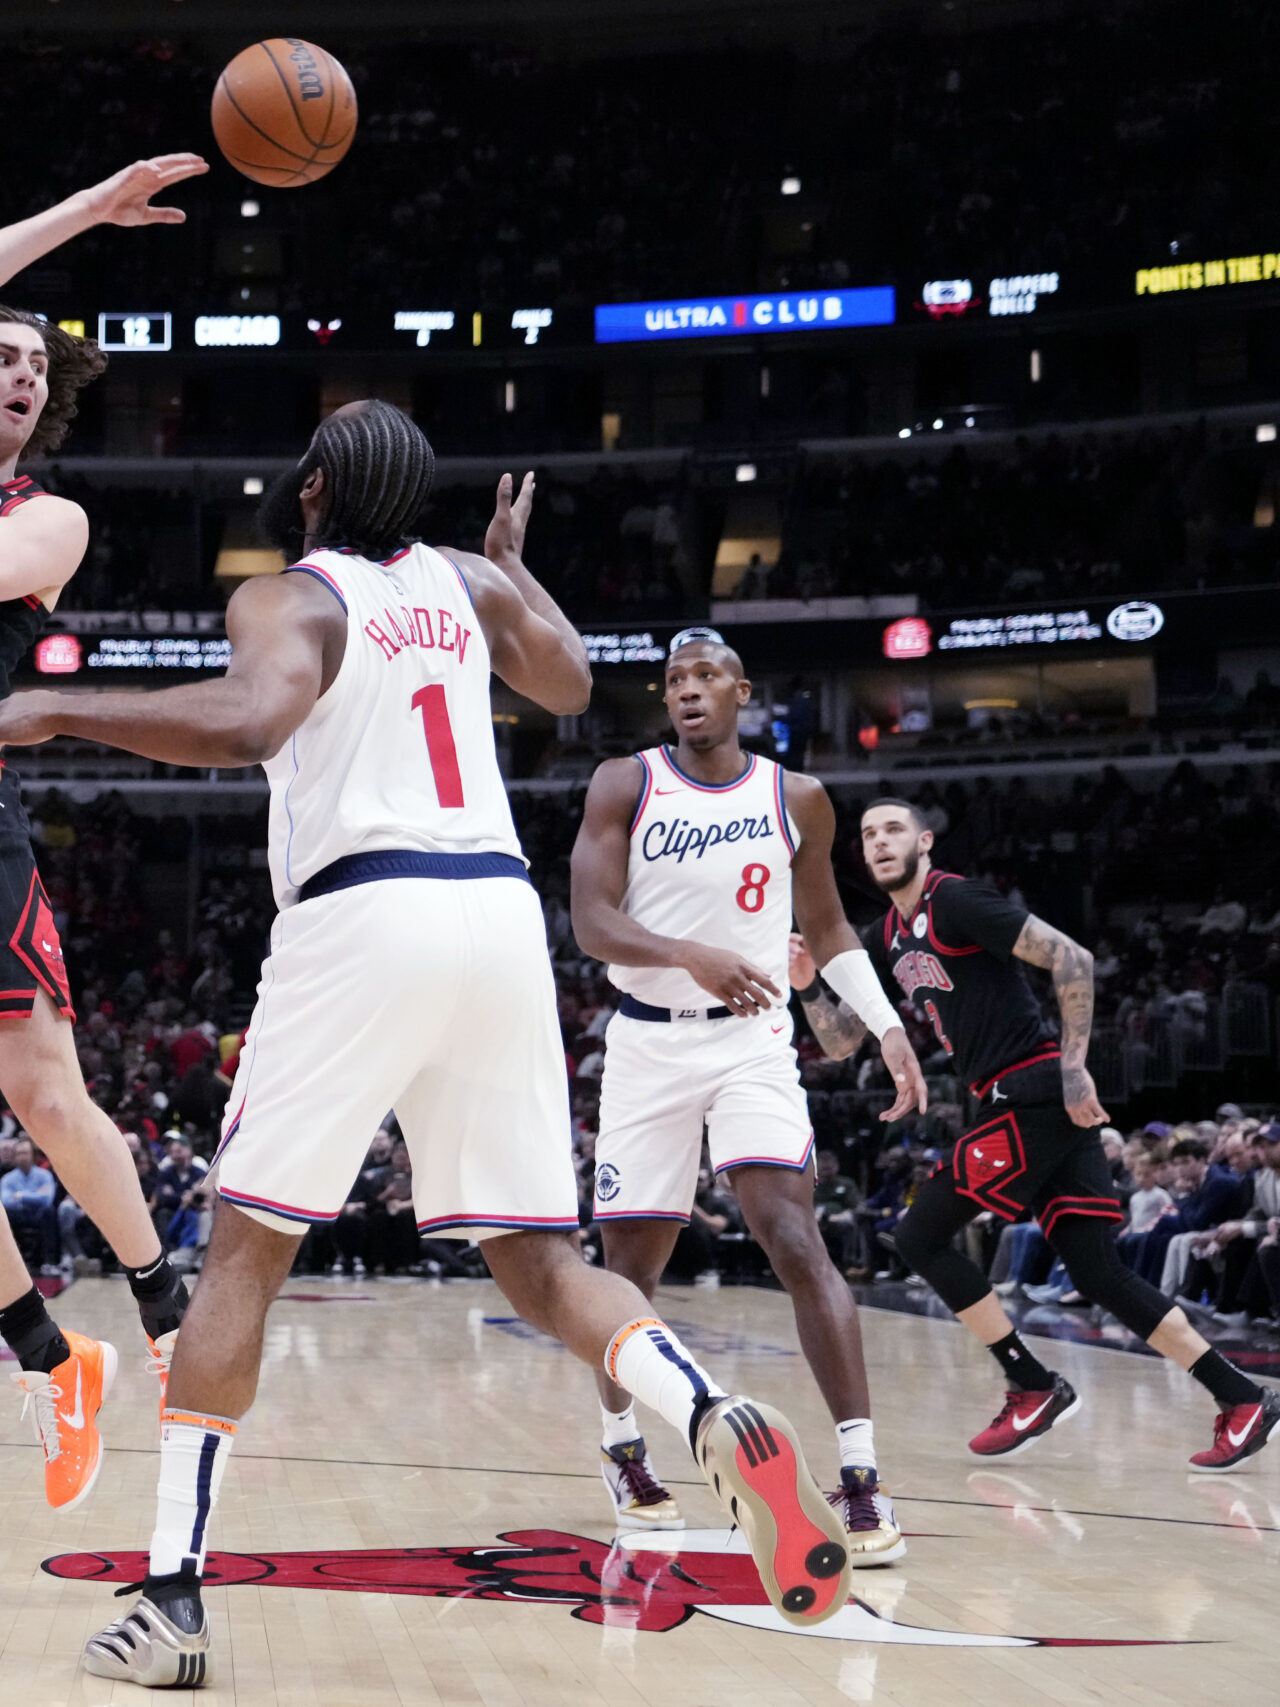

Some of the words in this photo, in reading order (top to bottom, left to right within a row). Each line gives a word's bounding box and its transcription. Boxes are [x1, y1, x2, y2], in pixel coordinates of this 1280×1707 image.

[1136, 262, 1203, 295] POINTS
[1204, 260, 1225, 287] IN
[1227, 255, 1261, 284] THE
[123, 317, 150, 346] 12
[195, 315, 280, 346] CHICAGO
[645, 305, 727, 331] ULTRA
[753, 297, 842, 325] CLUB
[365, 606, 471, 664] HARDEN
[411, 684, 465, 809] 1
[643, 814, 773, 863] Clippers
[736, 863, 771, 913] 8
